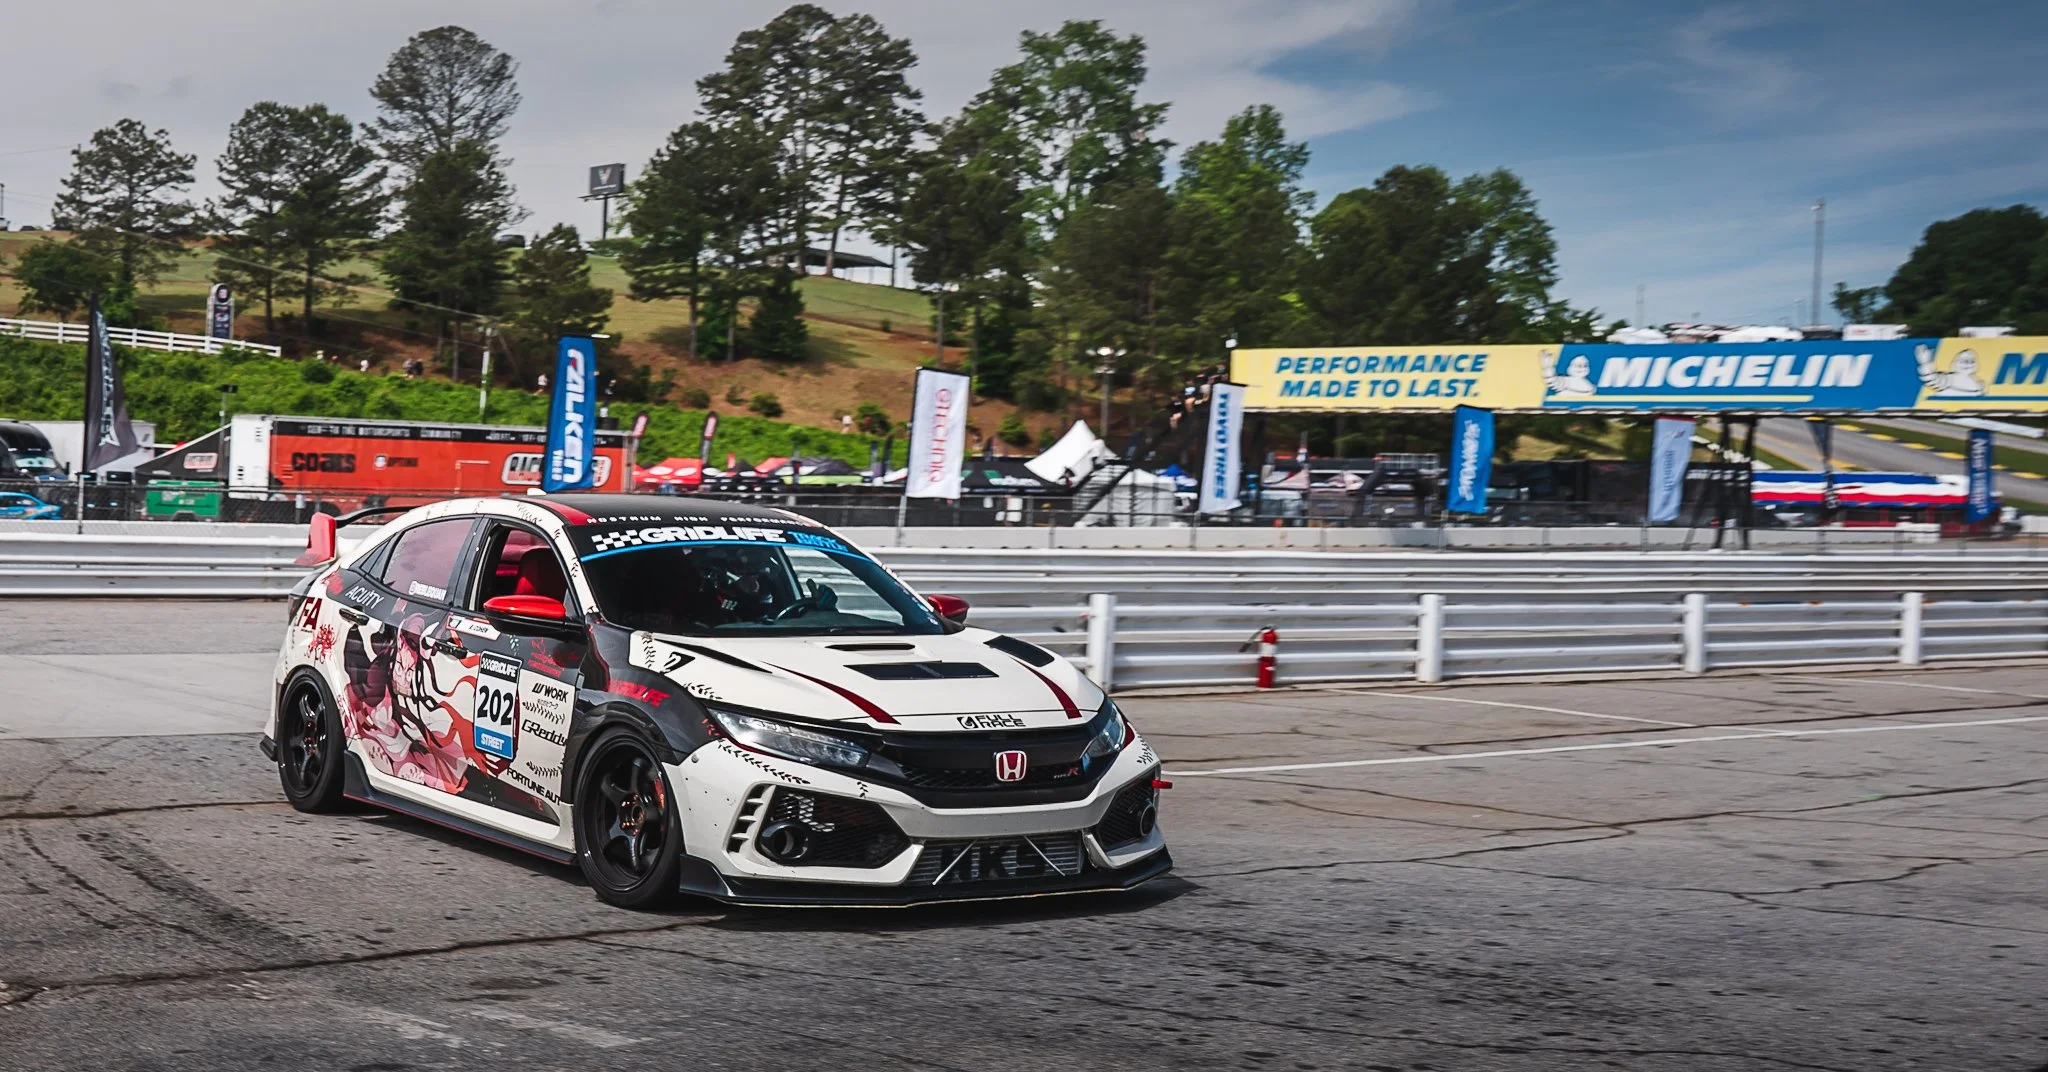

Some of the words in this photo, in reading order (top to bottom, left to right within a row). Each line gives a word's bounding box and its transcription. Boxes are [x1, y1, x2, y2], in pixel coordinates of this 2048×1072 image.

[1275, 354, 1489, 374] PERFORMANCE
[1600, 354, 1873, 388] MICHELIN
[1278, 379, 1361, 398] MADE
[1368, 379, 1401, 398] TO
[1408, 378, 1480, 398] LAST.
[562, 348, 585, 484] FALKEN
[1216, 393, 1230, 445] TOYO
[1214, 447, 1228, 499] TIRES
[638, 525, 787, 543] GRIDLIFE
[489, 659, 518, 678] GRIDLIFE
[544, 685, 569, 703] WORK
[477, 685, 514, 726] 202
[974, 713, 1023, 723] FULL
[980, 719, 1027, 729] RACE
[481, 733, 505, 751] STREET
[507, 768, 545, 797] FORTUNE
